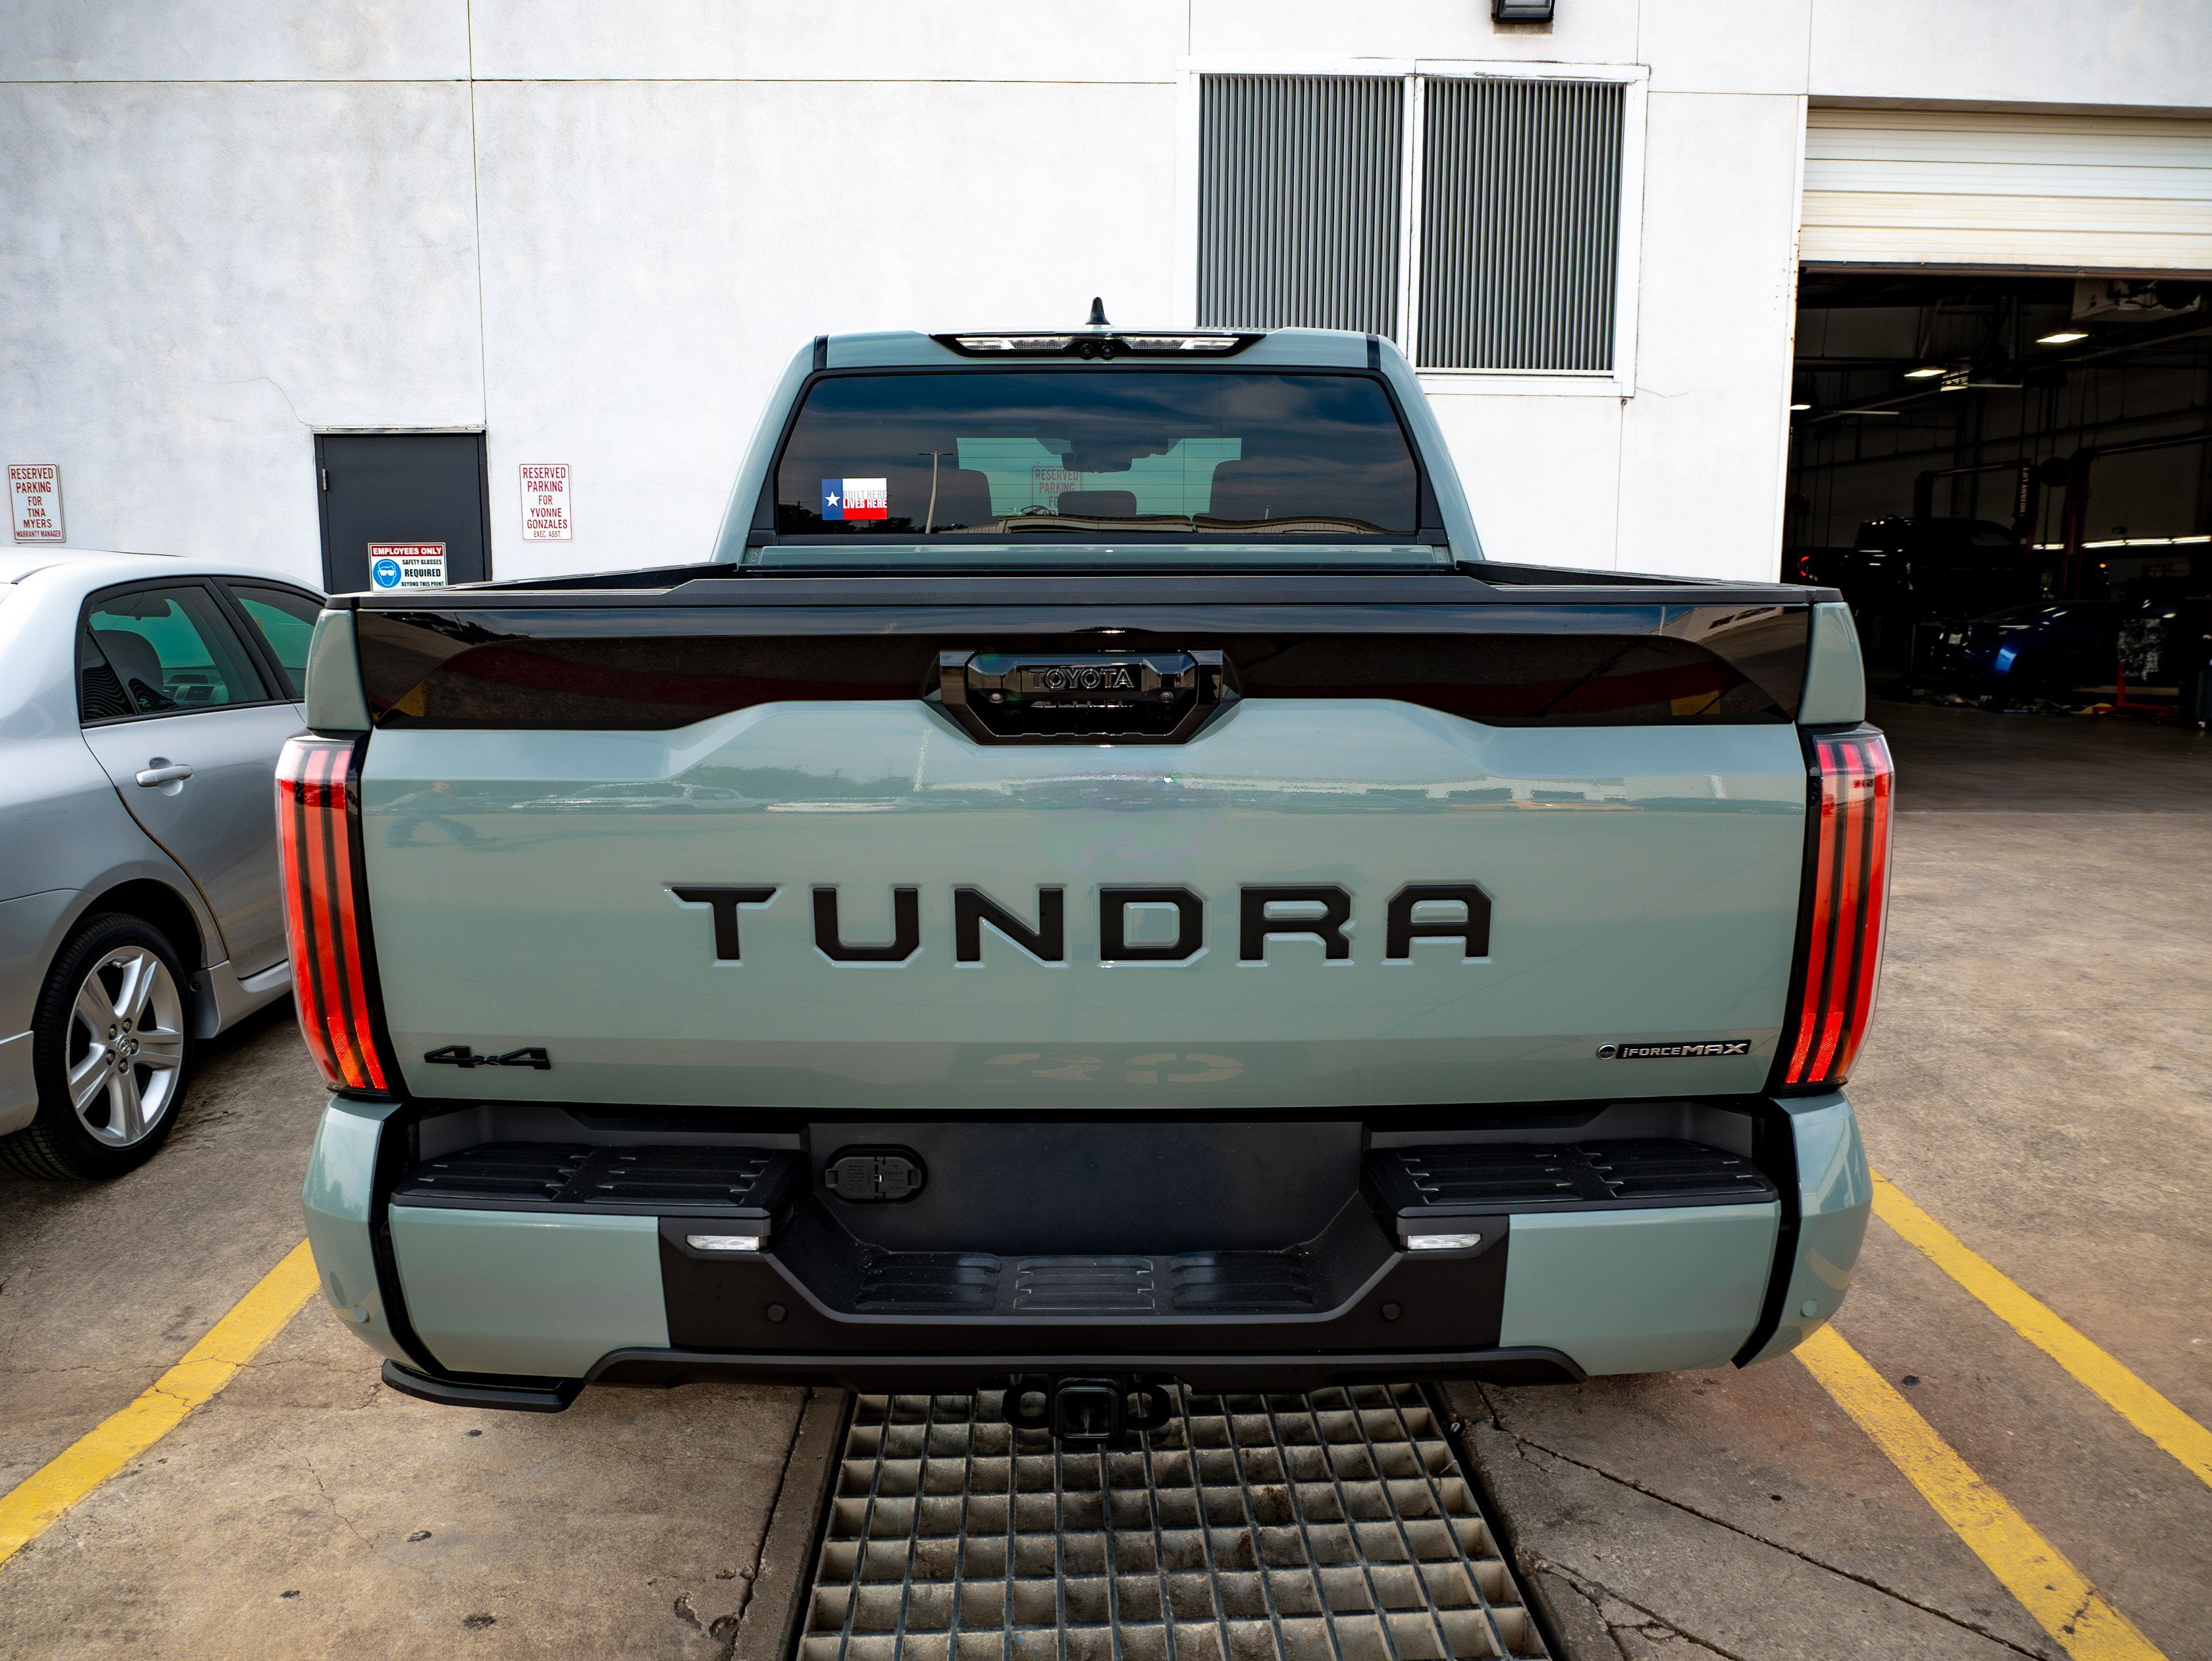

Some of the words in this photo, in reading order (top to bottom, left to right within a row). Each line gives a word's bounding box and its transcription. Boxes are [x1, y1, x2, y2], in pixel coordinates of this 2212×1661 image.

[10, 468, 54, 479] RESERVED
[523, 467, 566, 478] RESERVED
[1035, 469, 1078, 480] RESERVED
[16, 482, 51, 493] PARKING
[528, 480, 563, 491] PARKING
[1039, 482, 1075, 494] PARKING
[843, 490, 865, 499] BUILT
[867, 490, 887, 499] HERE
[28, 496, 42, 506] FOR
[539, 495, 552, 505] FOR
[843, 499, 865, 508] LIVES
[866, 498, 887, 508] HERE
[27, 508, 46, 517] TINA
[530, 508, 562, 517] YVONNE
[24, 519, 52, 528] MYERS
[527, 520, 567, 528] GONZALES
[404, 569, 441, 577] REQUIRED
[1029, 668, 1134, 689] TOYOTA
[666, 883, 1493, 966] TUNDRA
